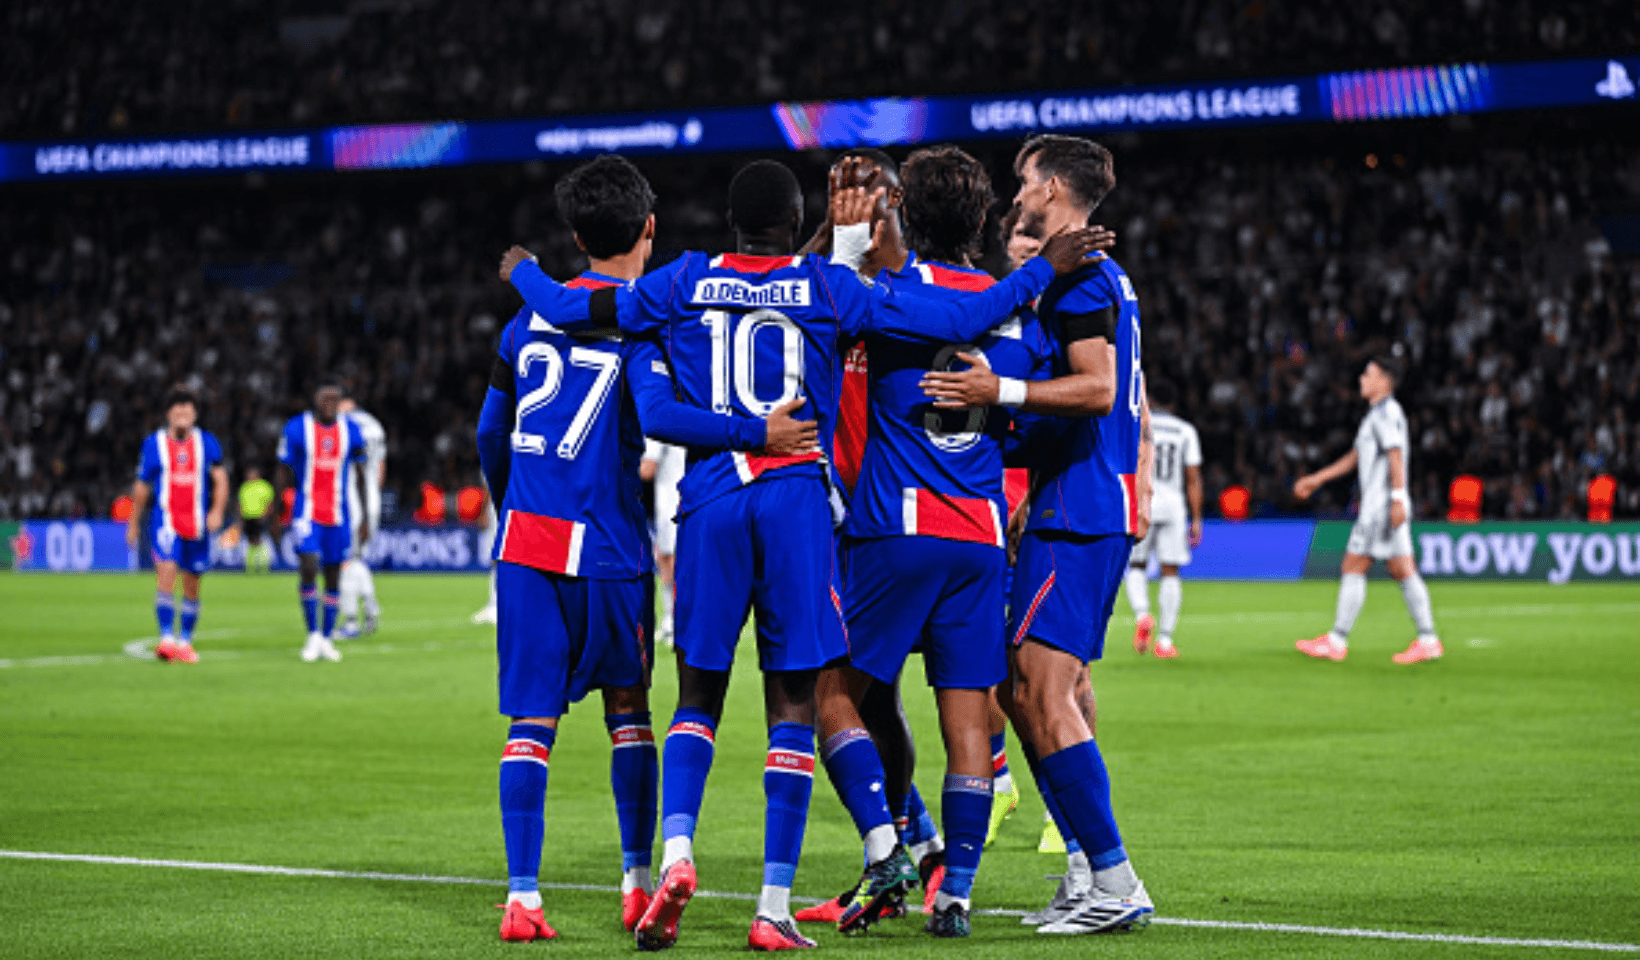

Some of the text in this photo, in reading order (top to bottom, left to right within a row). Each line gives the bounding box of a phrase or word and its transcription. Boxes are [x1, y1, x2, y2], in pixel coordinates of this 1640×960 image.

[1039, 90, 1193, 128] CHAMPIONS
[1196, 85, 1300, 120] LEAGUE
[93, 140, 220, 172] CHAMPIONS
[222, 135, 310, 167] LEAGUE
[700, 308, 805, 418] 10
[509, 341, 622, 460] 27
[1419, 531, 1538, 575] now
